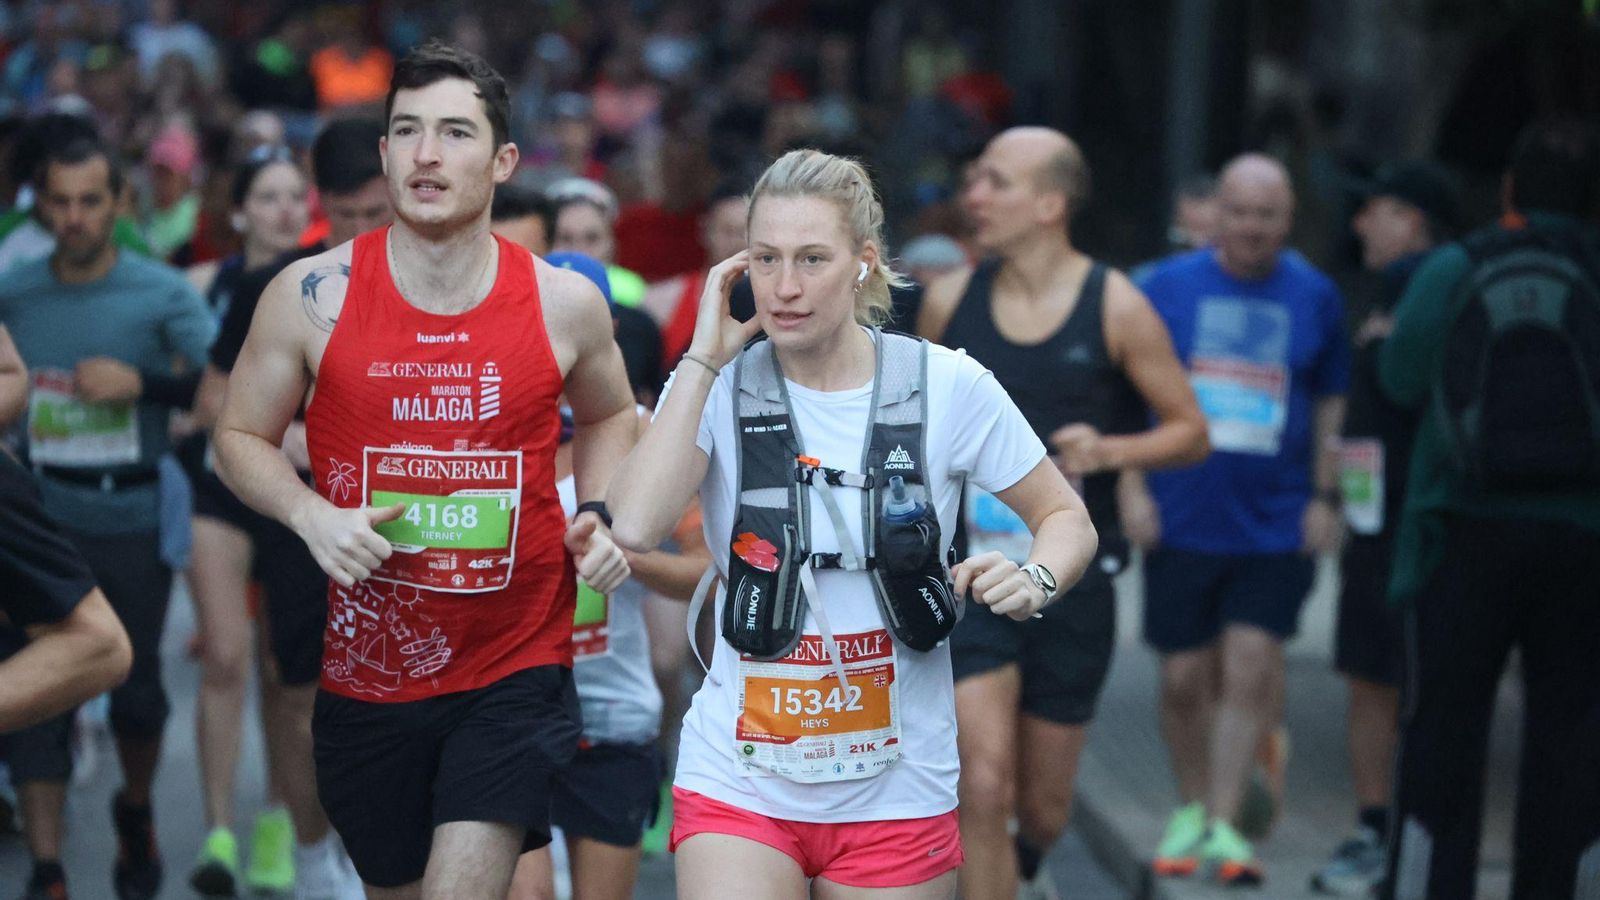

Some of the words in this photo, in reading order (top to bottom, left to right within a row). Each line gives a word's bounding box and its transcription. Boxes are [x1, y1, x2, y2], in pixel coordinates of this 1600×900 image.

[416, 332, 455, 343] luanvi
[392, 362, 473, 378] GENERALI
[392, 393, 474, 421] MÁLAGA
[407, 458, 508, 480] GENERALI
[404, 502, 479, 529] 4168
[420, 530, 463, 542] TIERNEY
[468, 558, 494, 569] 42K
[746, 585, 761, 631] AONIJIE
[918, 587, 945, 625] AONIJIE
[770, 686, 864, 716] 15342
[800, 718, 830, 729] HEYS
[849, 742, 877, 753] 21K
